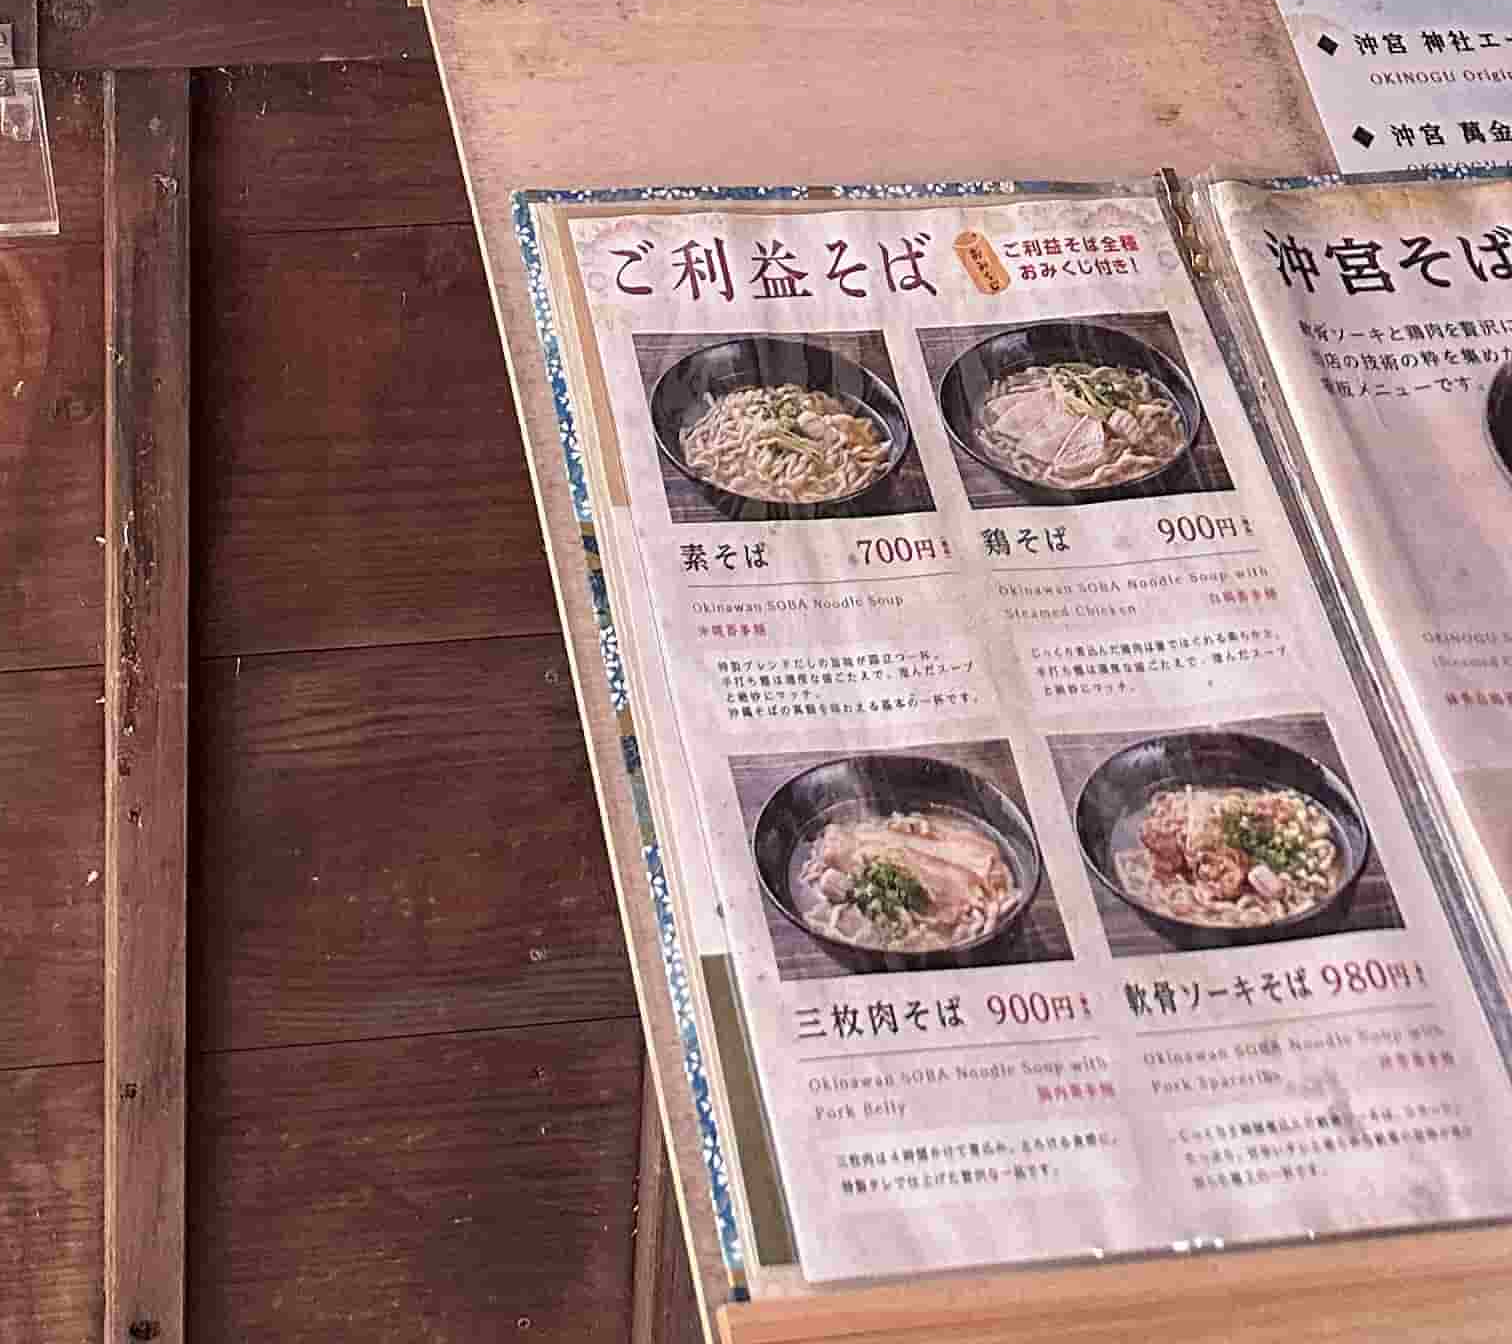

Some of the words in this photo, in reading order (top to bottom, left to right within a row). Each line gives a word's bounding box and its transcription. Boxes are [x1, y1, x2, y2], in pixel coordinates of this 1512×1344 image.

[1353, 30, 1408, 56] 沖宮
[1369, 69, 1457, 86] OKINOGU
[1390, 121, 1446, 148] 沖宮
[606, 231, 940, 303] ご利益そば
[1018, 255, 1138, 281] おみくじ付き!
[1263, 224, 1512, 296] 沖宮そば
[980, 526, 1071, 557] 鶏そば
[1156, 514, 1238, 544] 900円
[679, 541, 769, 572] 素そば
[855, 535, 937, 566] 700円
[1126, 574, 1184, 591] Noodle
[691, 600, 763, 614] Okinawan
[766, 597, 809, 612] SOBA
[813, 594, 864, 610] Noodle
[868, 593, 905, 608] Soup
[1124, 967, 1312, 1017] 軟骨ソーキそば
[794, 995, 965, 1041] 三枚肉そば
[986, 991, 1076, 1026] 900円
[808, 1074, 895, 1094] Okinawan
[900, 1067, 951, 1087] SOBA
[956, 1064, 1016, 1080] Noodle
[1022, 1059, 1064, 1079] Soup
[1070, 1055, 1108, 1074] with
[815, 1102, 856, 1121] Pork
[863, 1100, 907, 1119] Belly
